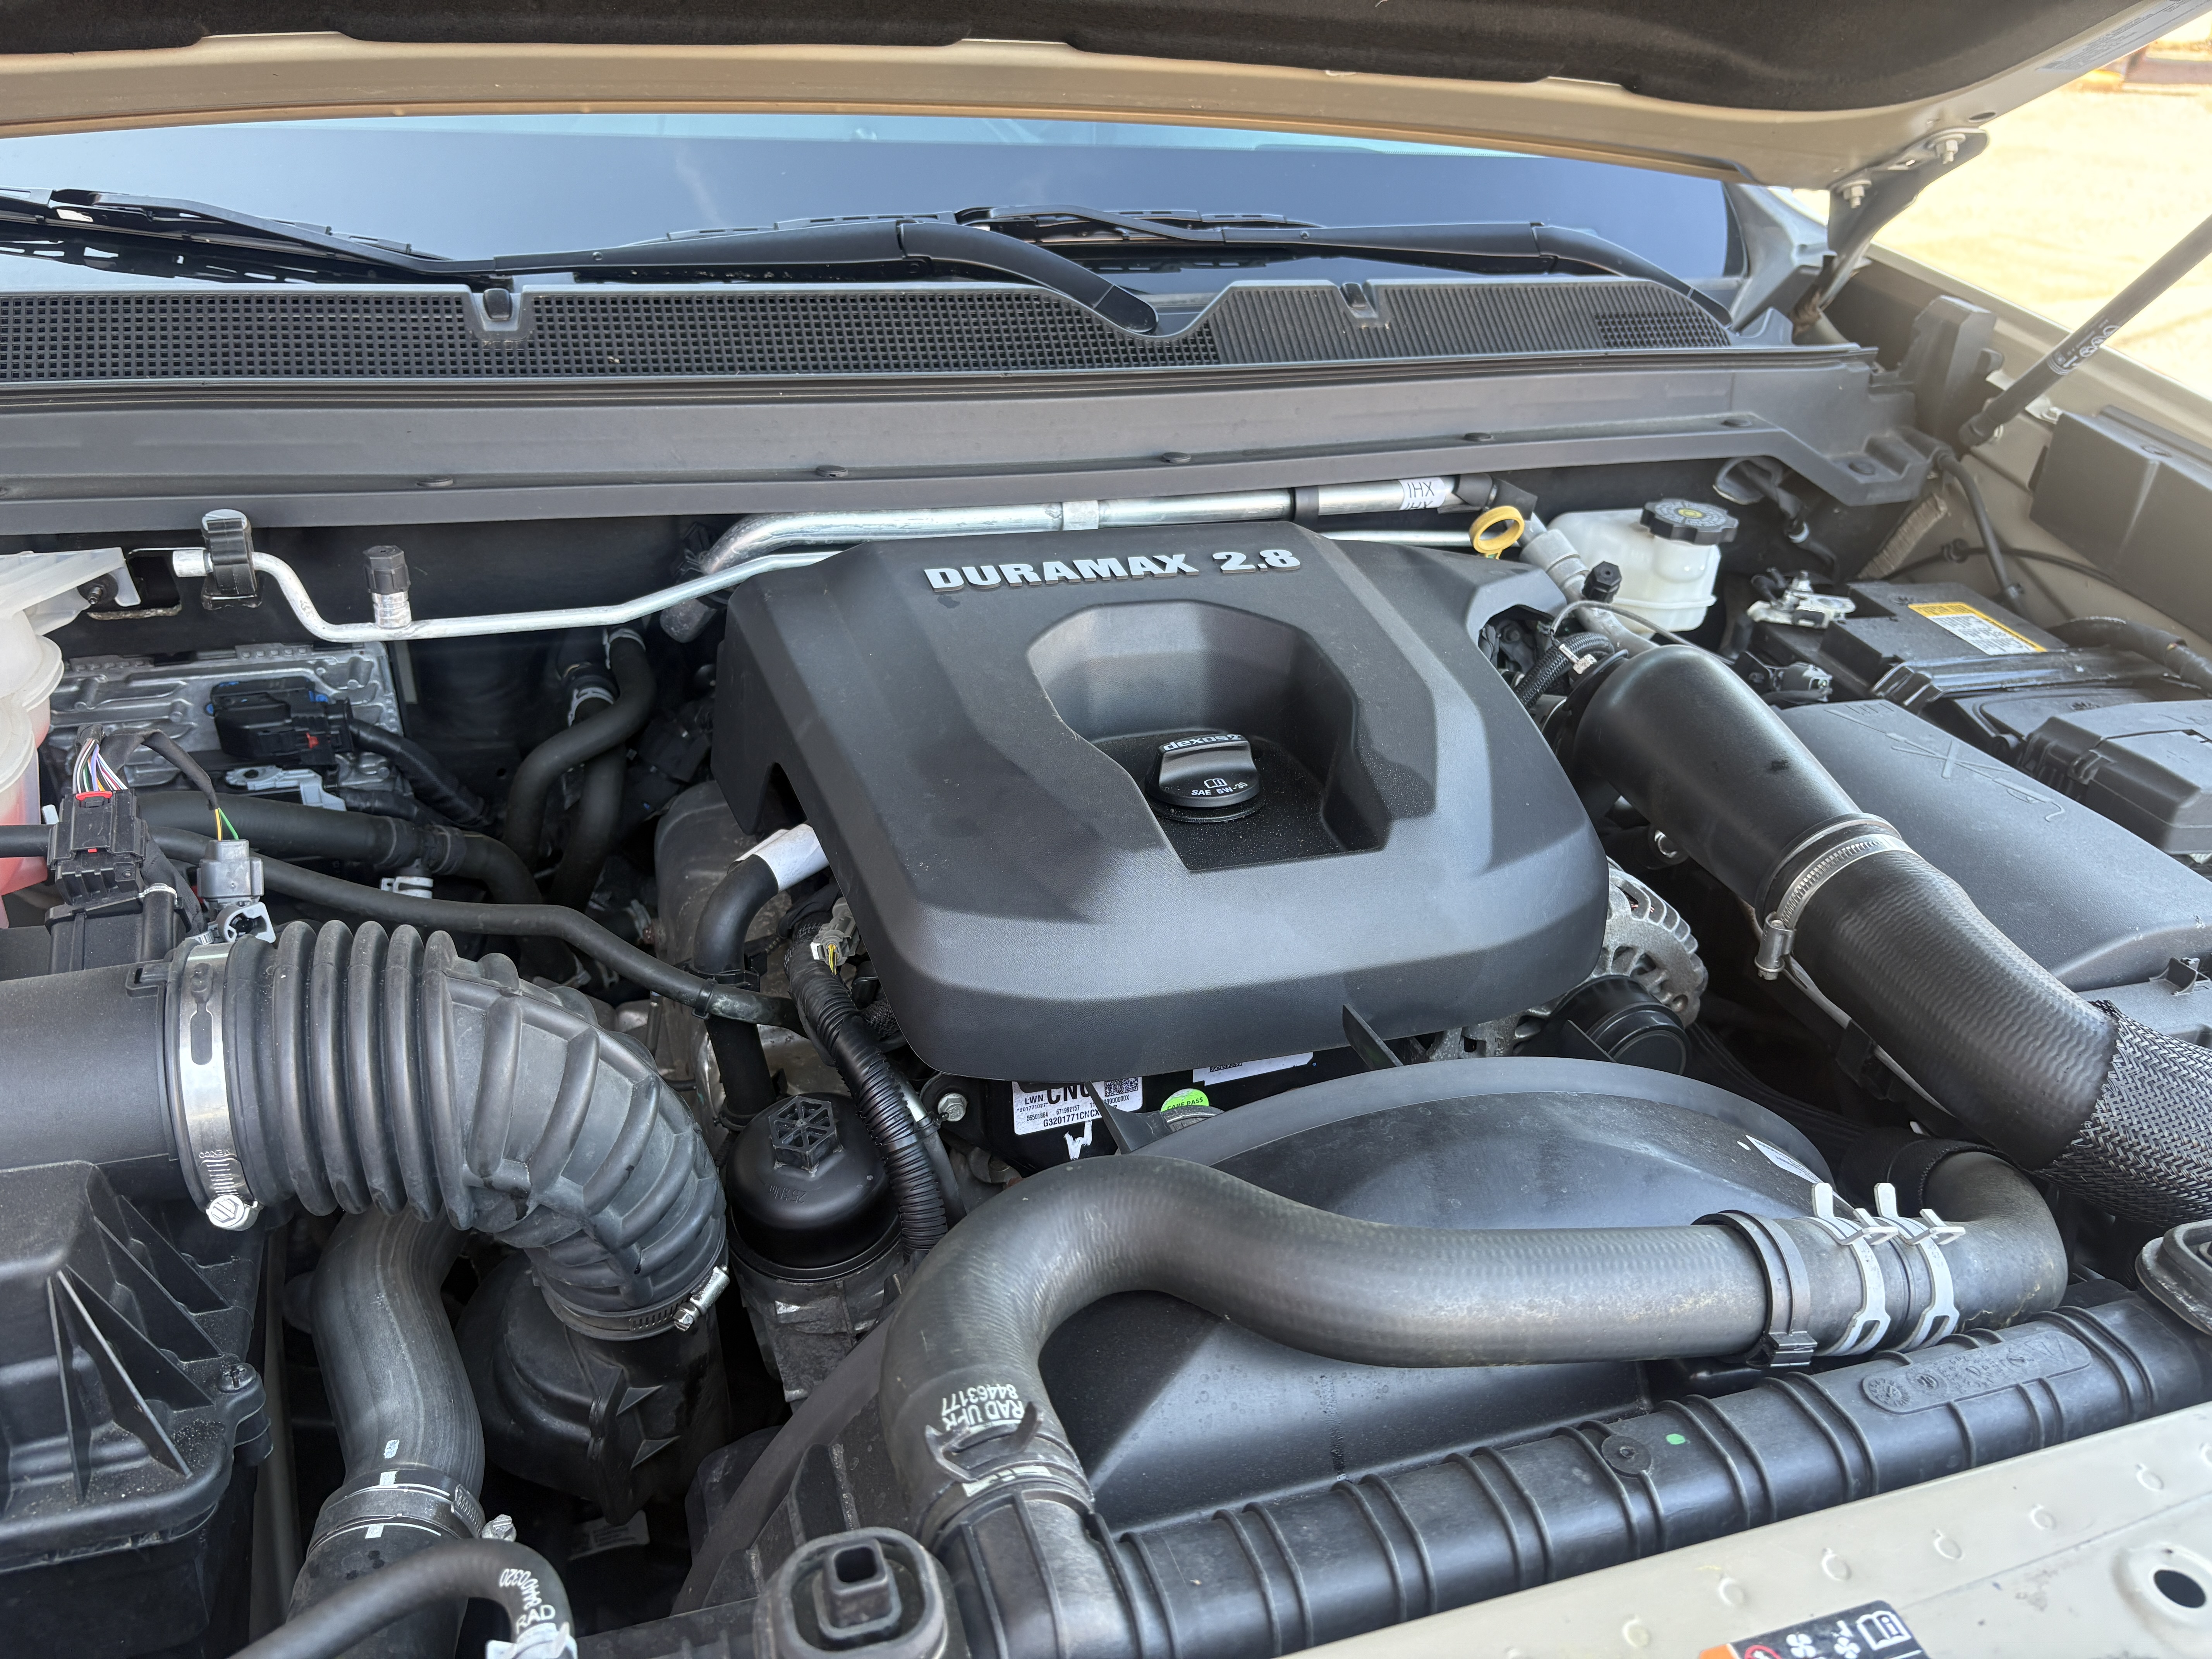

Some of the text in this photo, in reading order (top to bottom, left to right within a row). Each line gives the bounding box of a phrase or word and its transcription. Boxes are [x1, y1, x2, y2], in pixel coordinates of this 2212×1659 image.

[1407, 481, 1435, 498] IHX
[924, 549, 1300, 592] DURAMAX 2.8
[1163, 734, 1242, 751] dexos2
[1216, 782, 1248, 794] 5W-30
[1025, 1094, 1044, 1104] LWN
[1187, 1097, 1203, 1106] PASS
[1056, 1105, 1080, 1115] 671992157
[941, 1383, 1018, 1417] 84463177
[984, 1400, 1025, 1420] RAD
[516, 1604, 556, 1634] RAD
